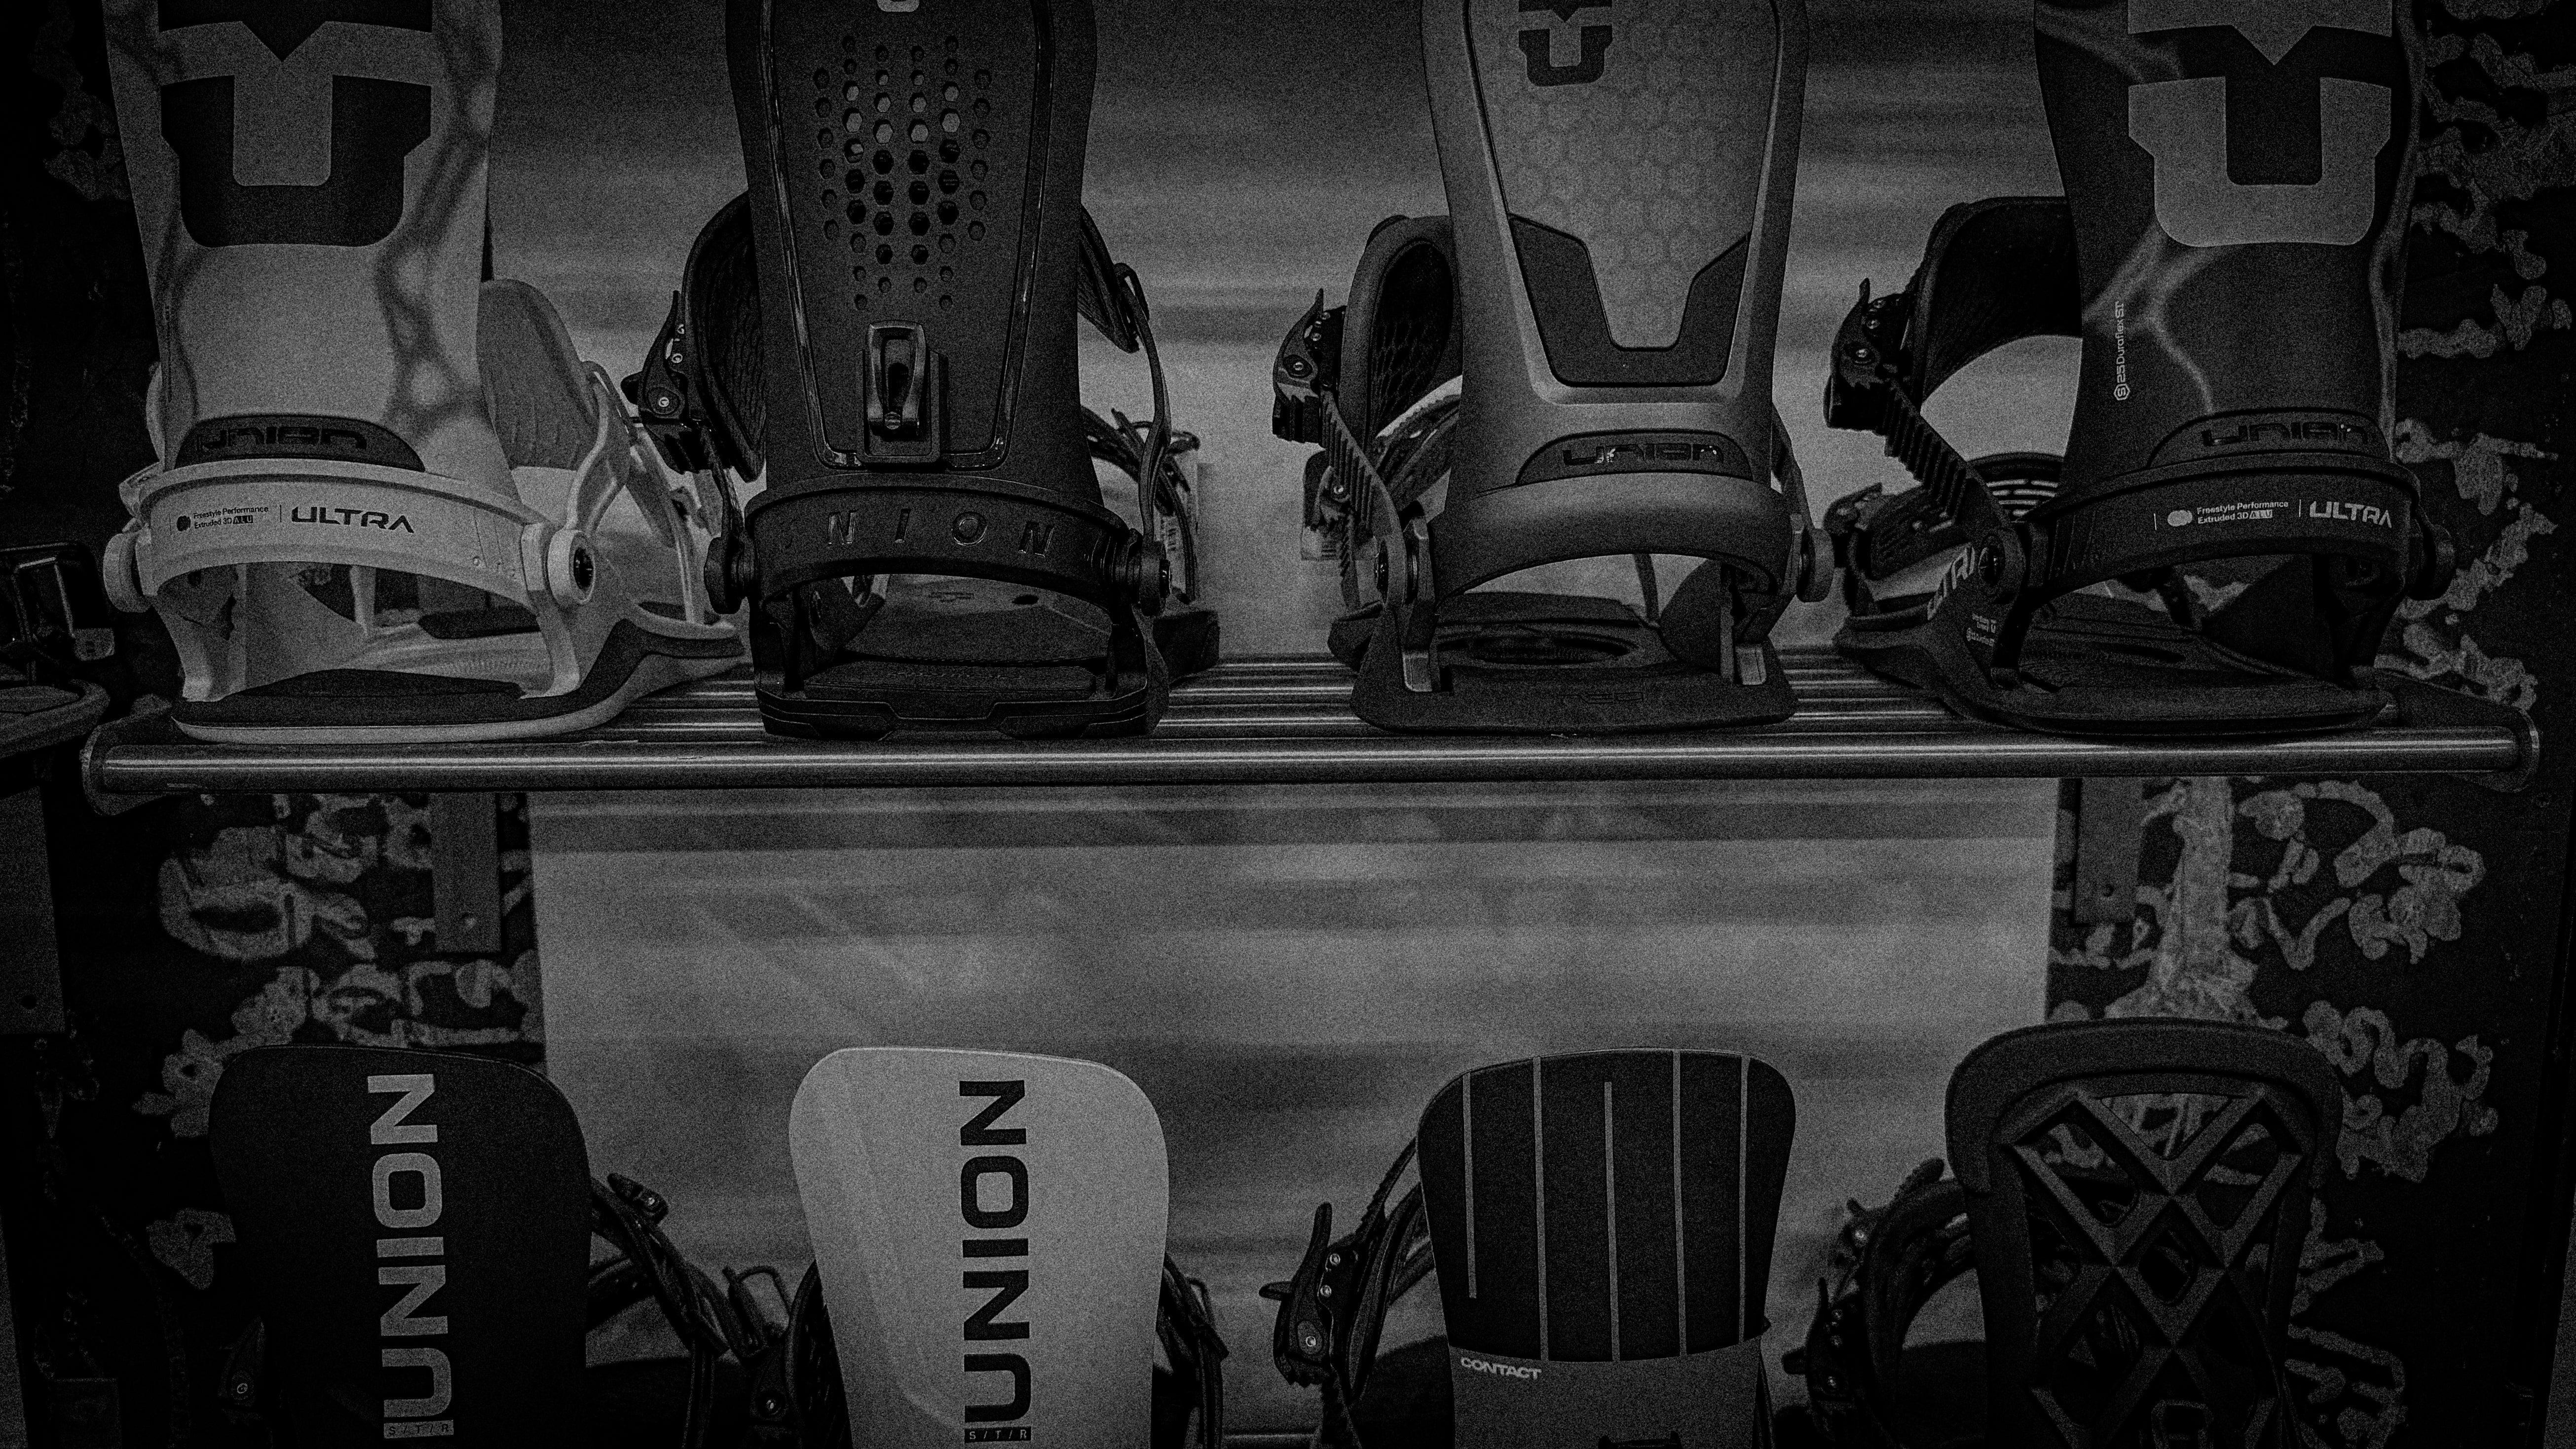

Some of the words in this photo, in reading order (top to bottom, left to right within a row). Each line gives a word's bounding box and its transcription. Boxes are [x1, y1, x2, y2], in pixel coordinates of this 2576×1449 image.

[193, 510, 221, 519] Freestyle
[223, 507, 268, 515] Performance
[292, 507, 414, 533] ULTRA
[2197, 504, 2235, 515] Freestyle
[2237, 501, 2289, 510] Performance
[2198, 513, 2235, 524] Extruded
[2310, 501, 2392, 528] ULTRA
[194, 519, 221, 529] Extruded
[784, 508, 1055, 557] NION
[367, 1073, 453, 1418] UNION
[960, 1080, 1031, 1423] UNION
[1460, 1357, 1542, 1380] CONTACT
